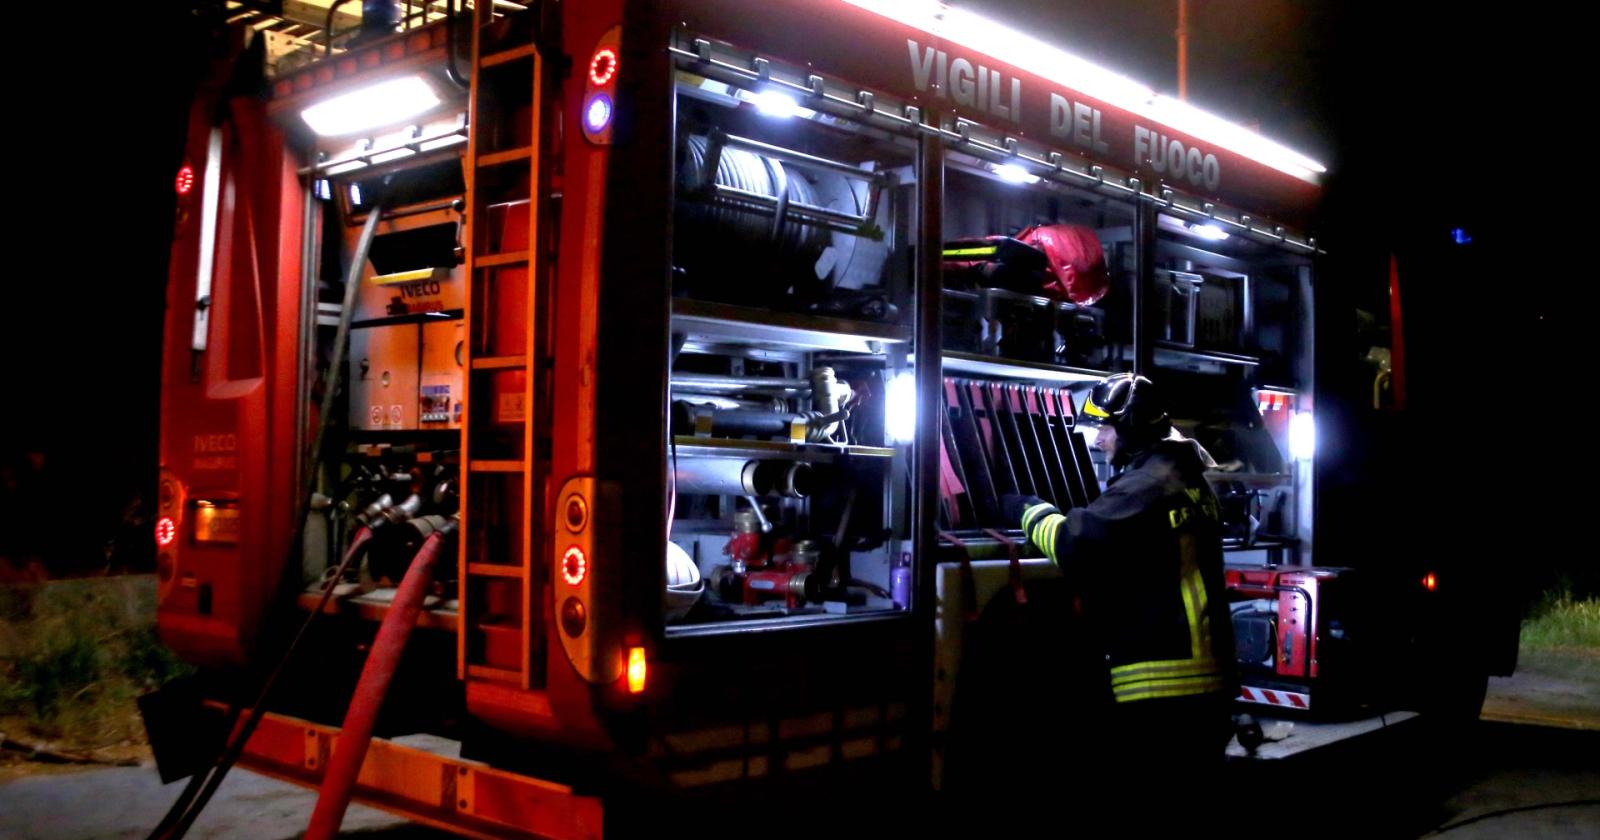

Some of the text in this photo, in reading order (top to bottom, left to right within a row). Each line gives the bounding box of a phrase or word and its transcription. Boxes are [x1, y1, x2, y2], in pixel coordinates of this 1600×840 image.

[907, 39, 1220, 191] VIGILI DEL FUOCO
[399, 281, 440, 299] IVECO
[193, 433, 236, 453] IVECO
